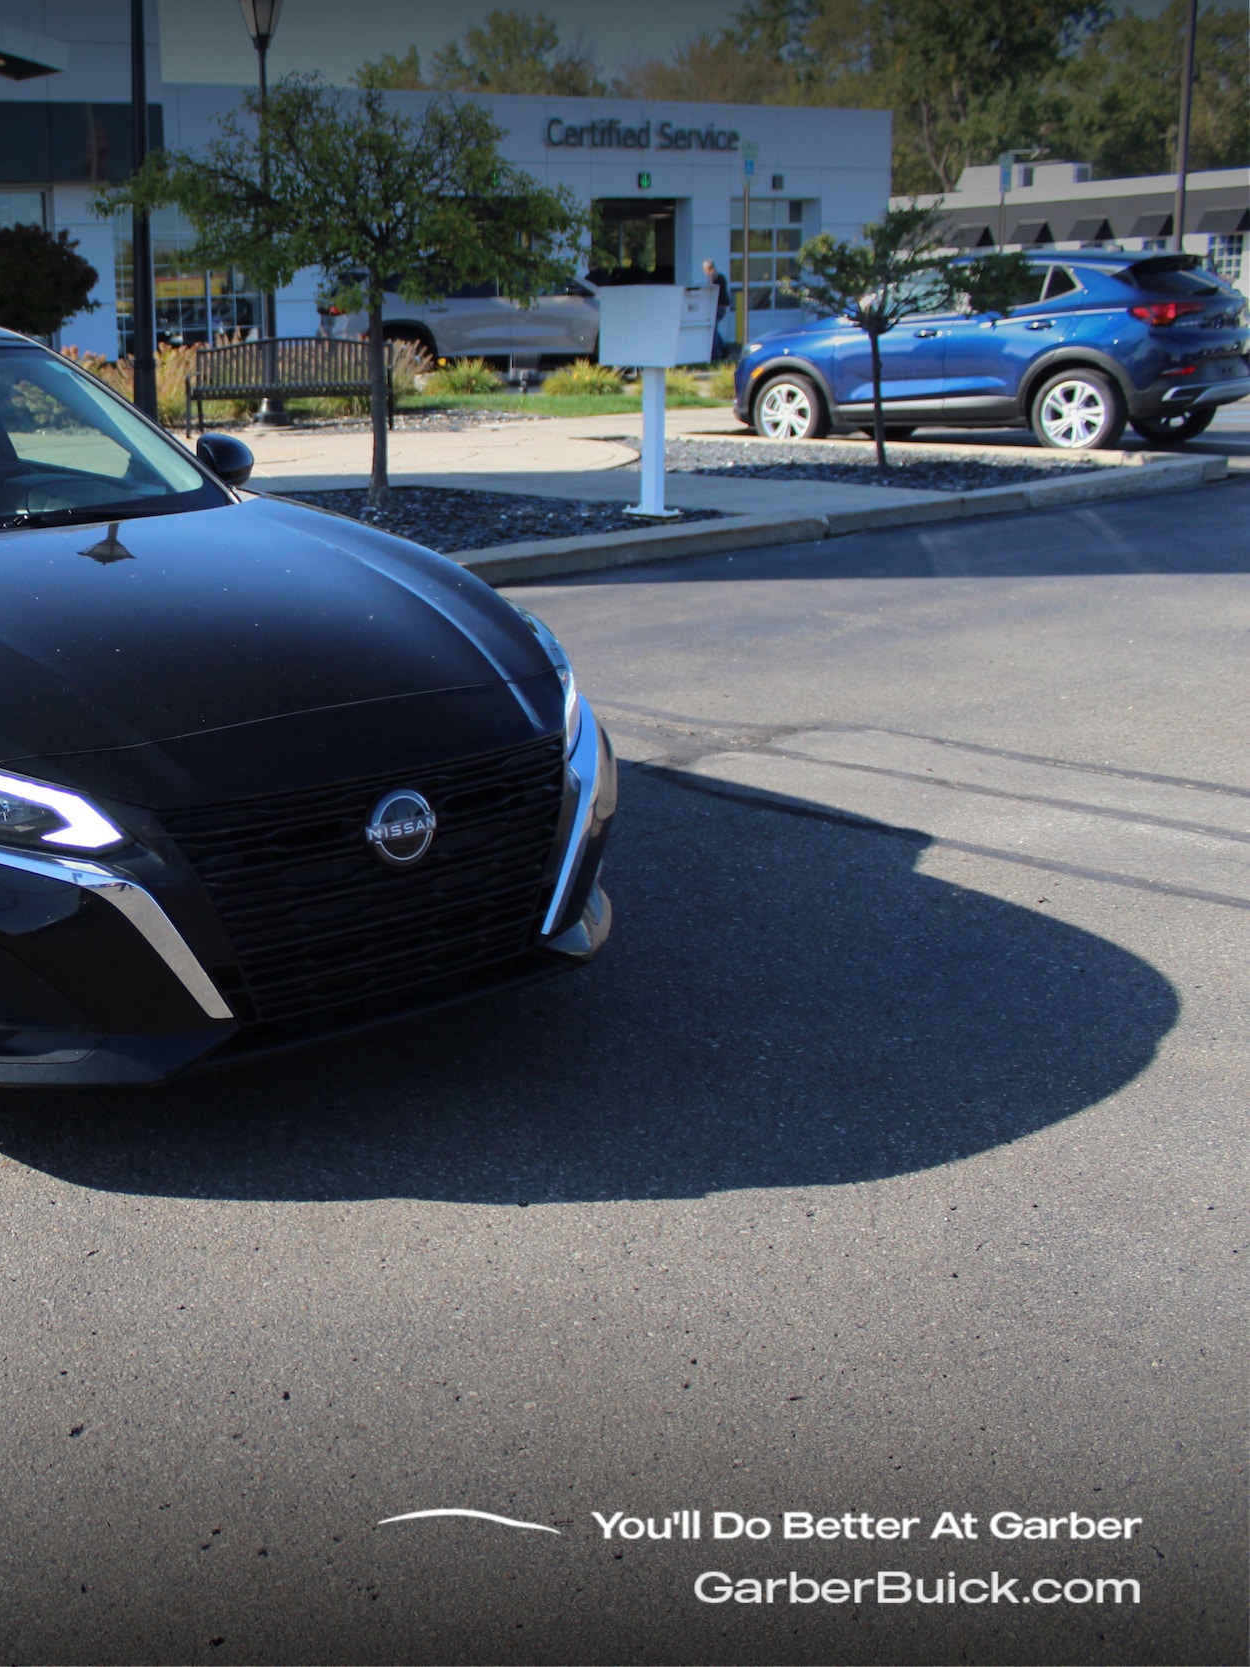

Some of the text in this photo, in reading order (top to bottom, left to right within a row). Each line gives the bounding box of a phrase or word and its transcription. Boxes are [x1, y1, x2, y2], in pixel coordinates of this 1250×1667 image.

[546, 117, 650, 149] Certified
[659, 121, 739, 151] Service
[368, 815, 436, 841] NISSAN
